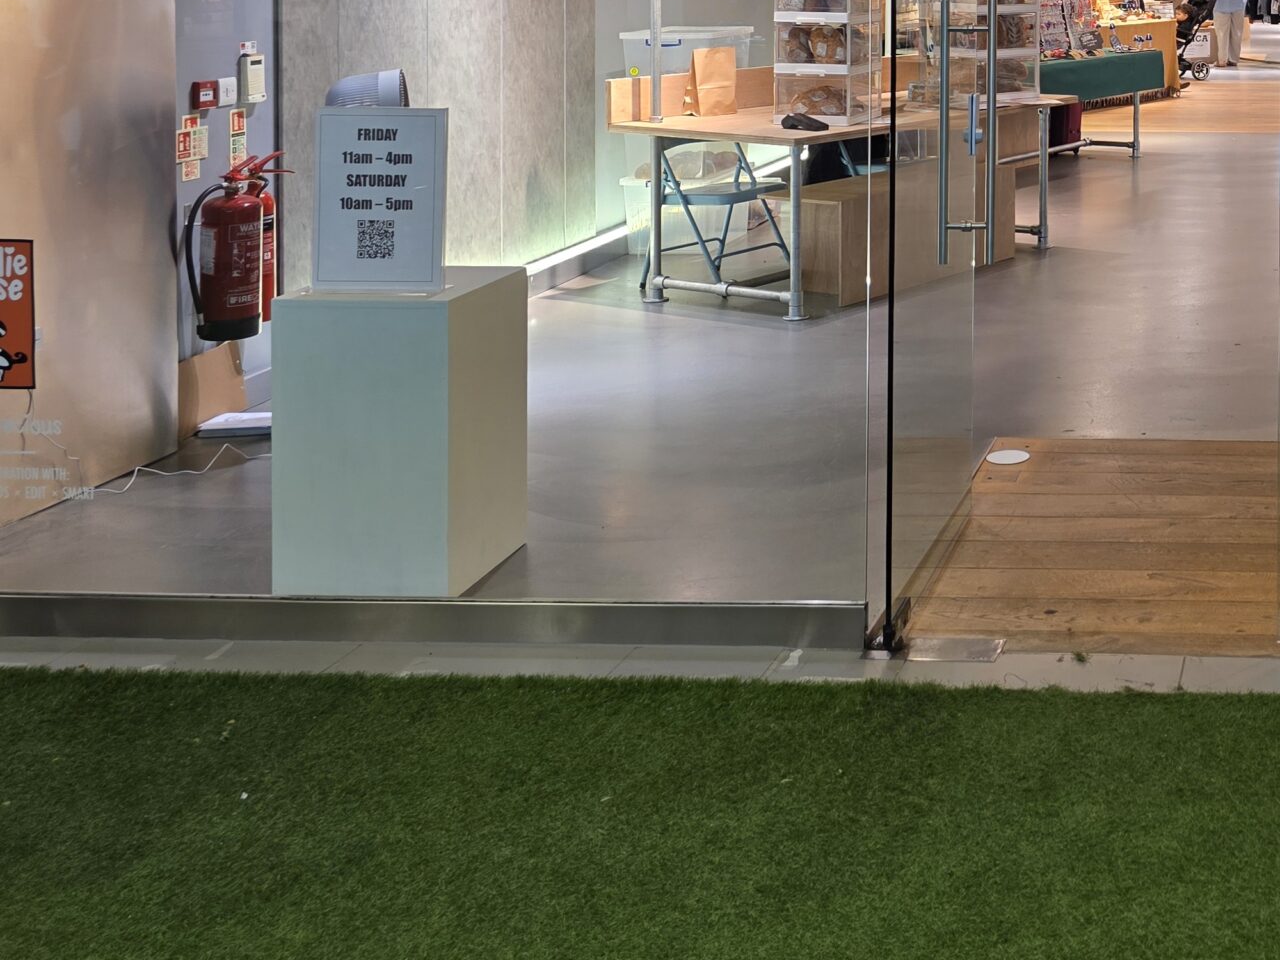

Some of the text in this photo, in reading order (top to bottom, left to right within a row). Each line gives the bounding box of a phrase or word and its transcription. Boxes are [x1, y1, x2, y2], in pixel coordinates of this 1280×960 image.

[357, 128, 398, 141] FRIDAY
[341, 151, 373, 164] 11am
[385, 151, 413, 165] 4pm
[346, 174, 407, 187] SATURDAY
[339, 197, 373, 210] 10am
[385, 197, 413, 211] 5pm
[62, 486, 95, 500] SMART
